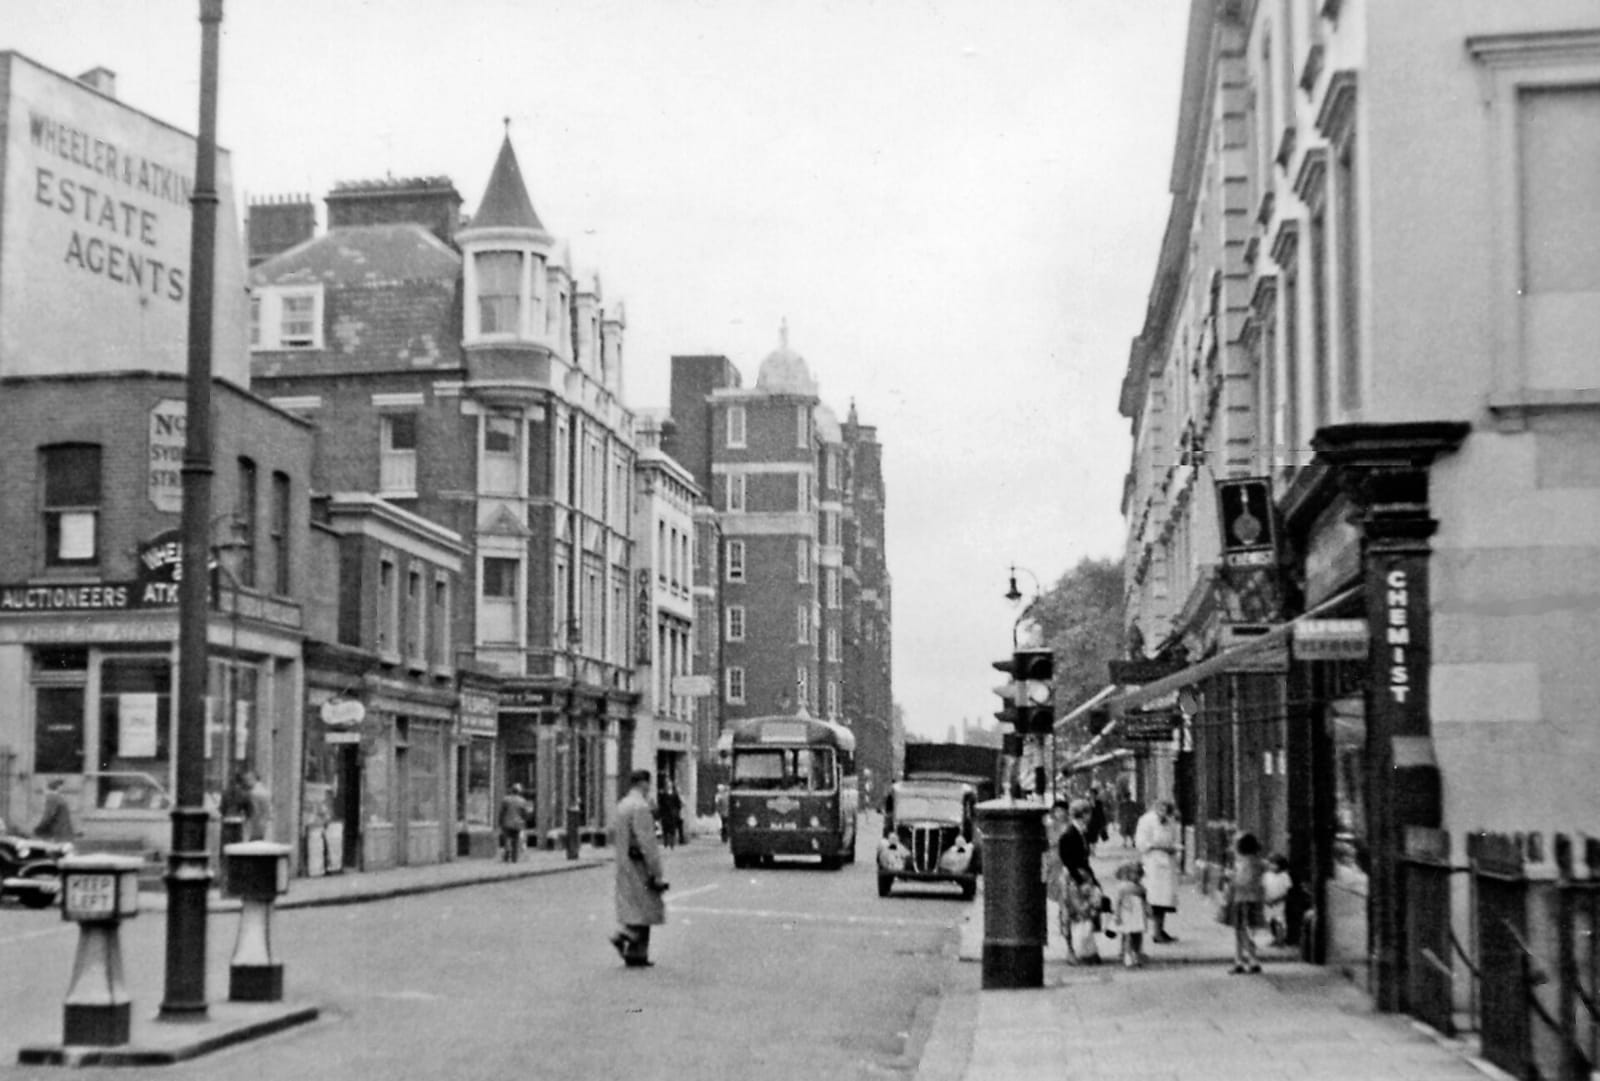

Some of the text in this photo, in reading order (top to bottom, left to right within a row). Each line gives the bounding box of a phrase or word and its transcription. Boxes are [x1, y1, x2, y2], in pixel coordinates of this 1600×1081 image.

[28, 110, 118, 181] WHEELER
[138, 157, 194, 207] ATKIN
[36, 165, 157, 247] ESTATE
[64, 229, 184, 302] AGENTS
[2, 586, 128, 609] AUCTIONEERS
[1387, 570, 1410, 703] CHEMIST
